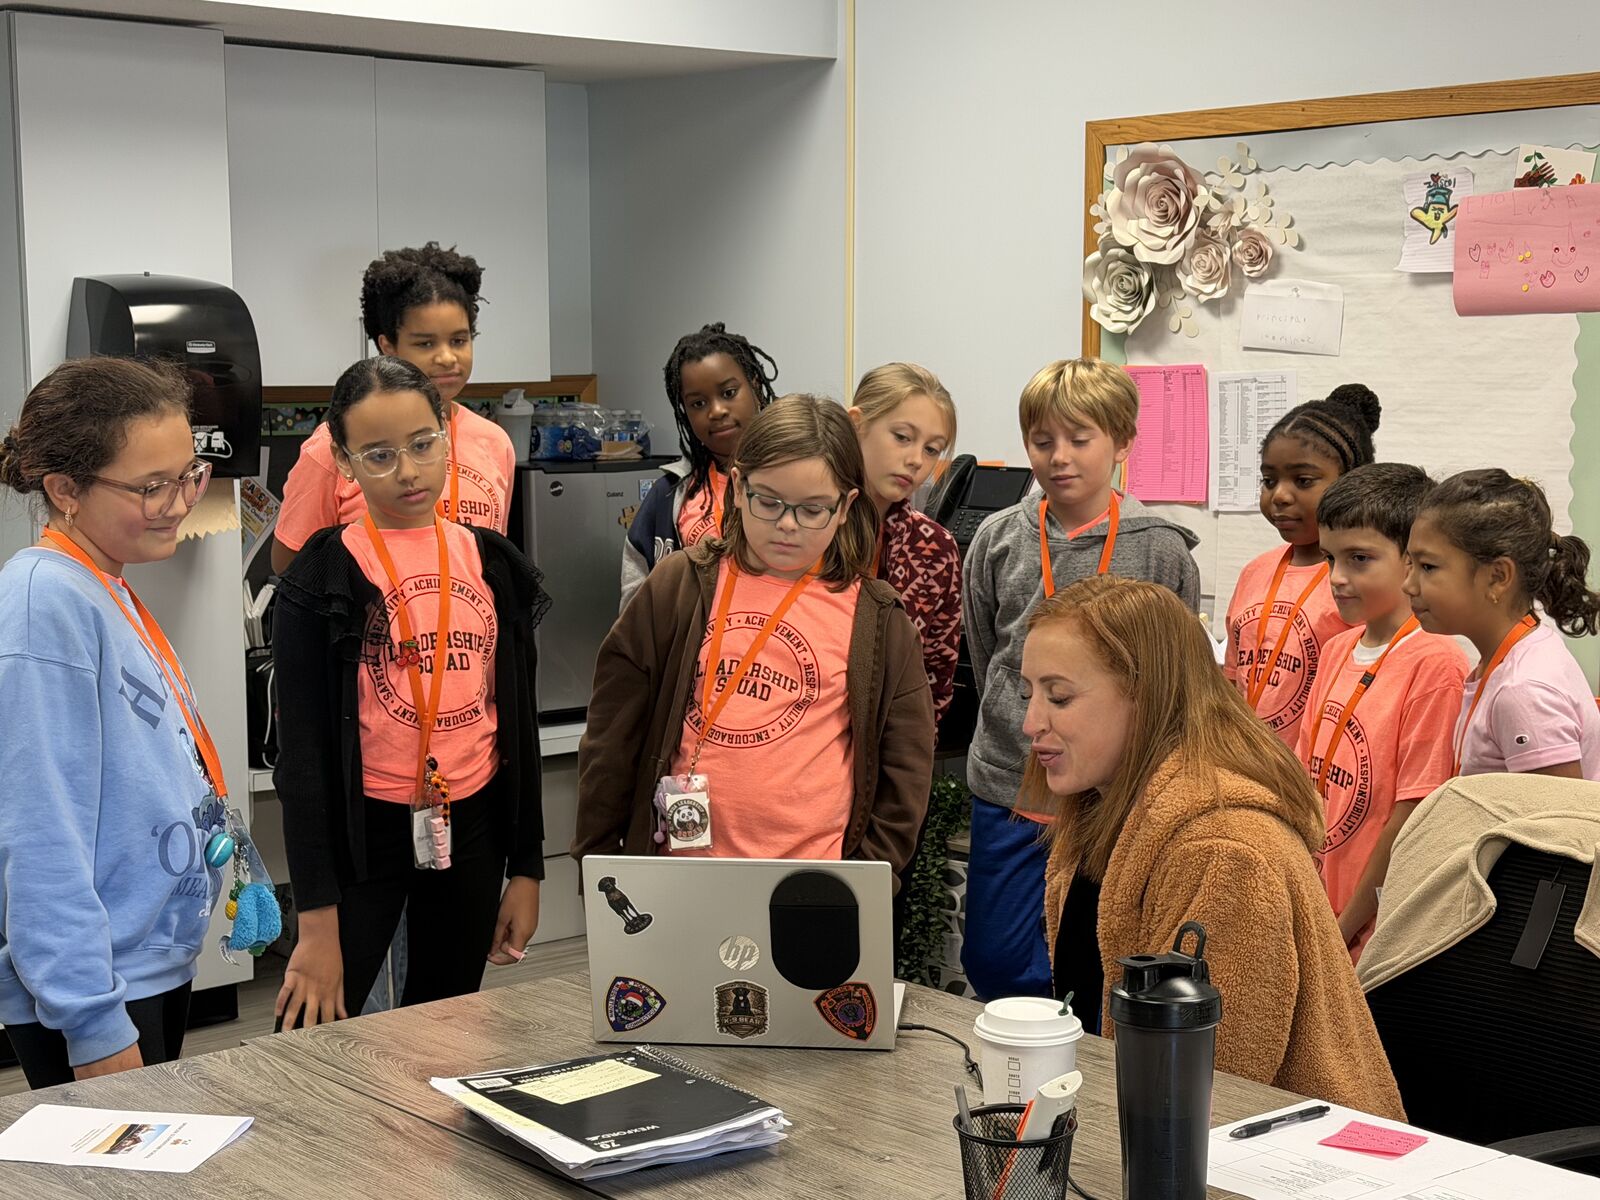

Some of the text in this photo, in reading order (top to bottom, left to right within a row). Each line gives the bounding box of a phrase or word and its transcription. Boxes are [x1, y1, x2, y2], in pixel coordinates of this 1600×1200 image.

[715, 677, 772, 702] SUAD
[1290, 637, 1319, 716] RESPONSIBILITY
[1340, 755, 1369, 836] RESPONSIBILITY
[722, 936, 758, 971] hp
